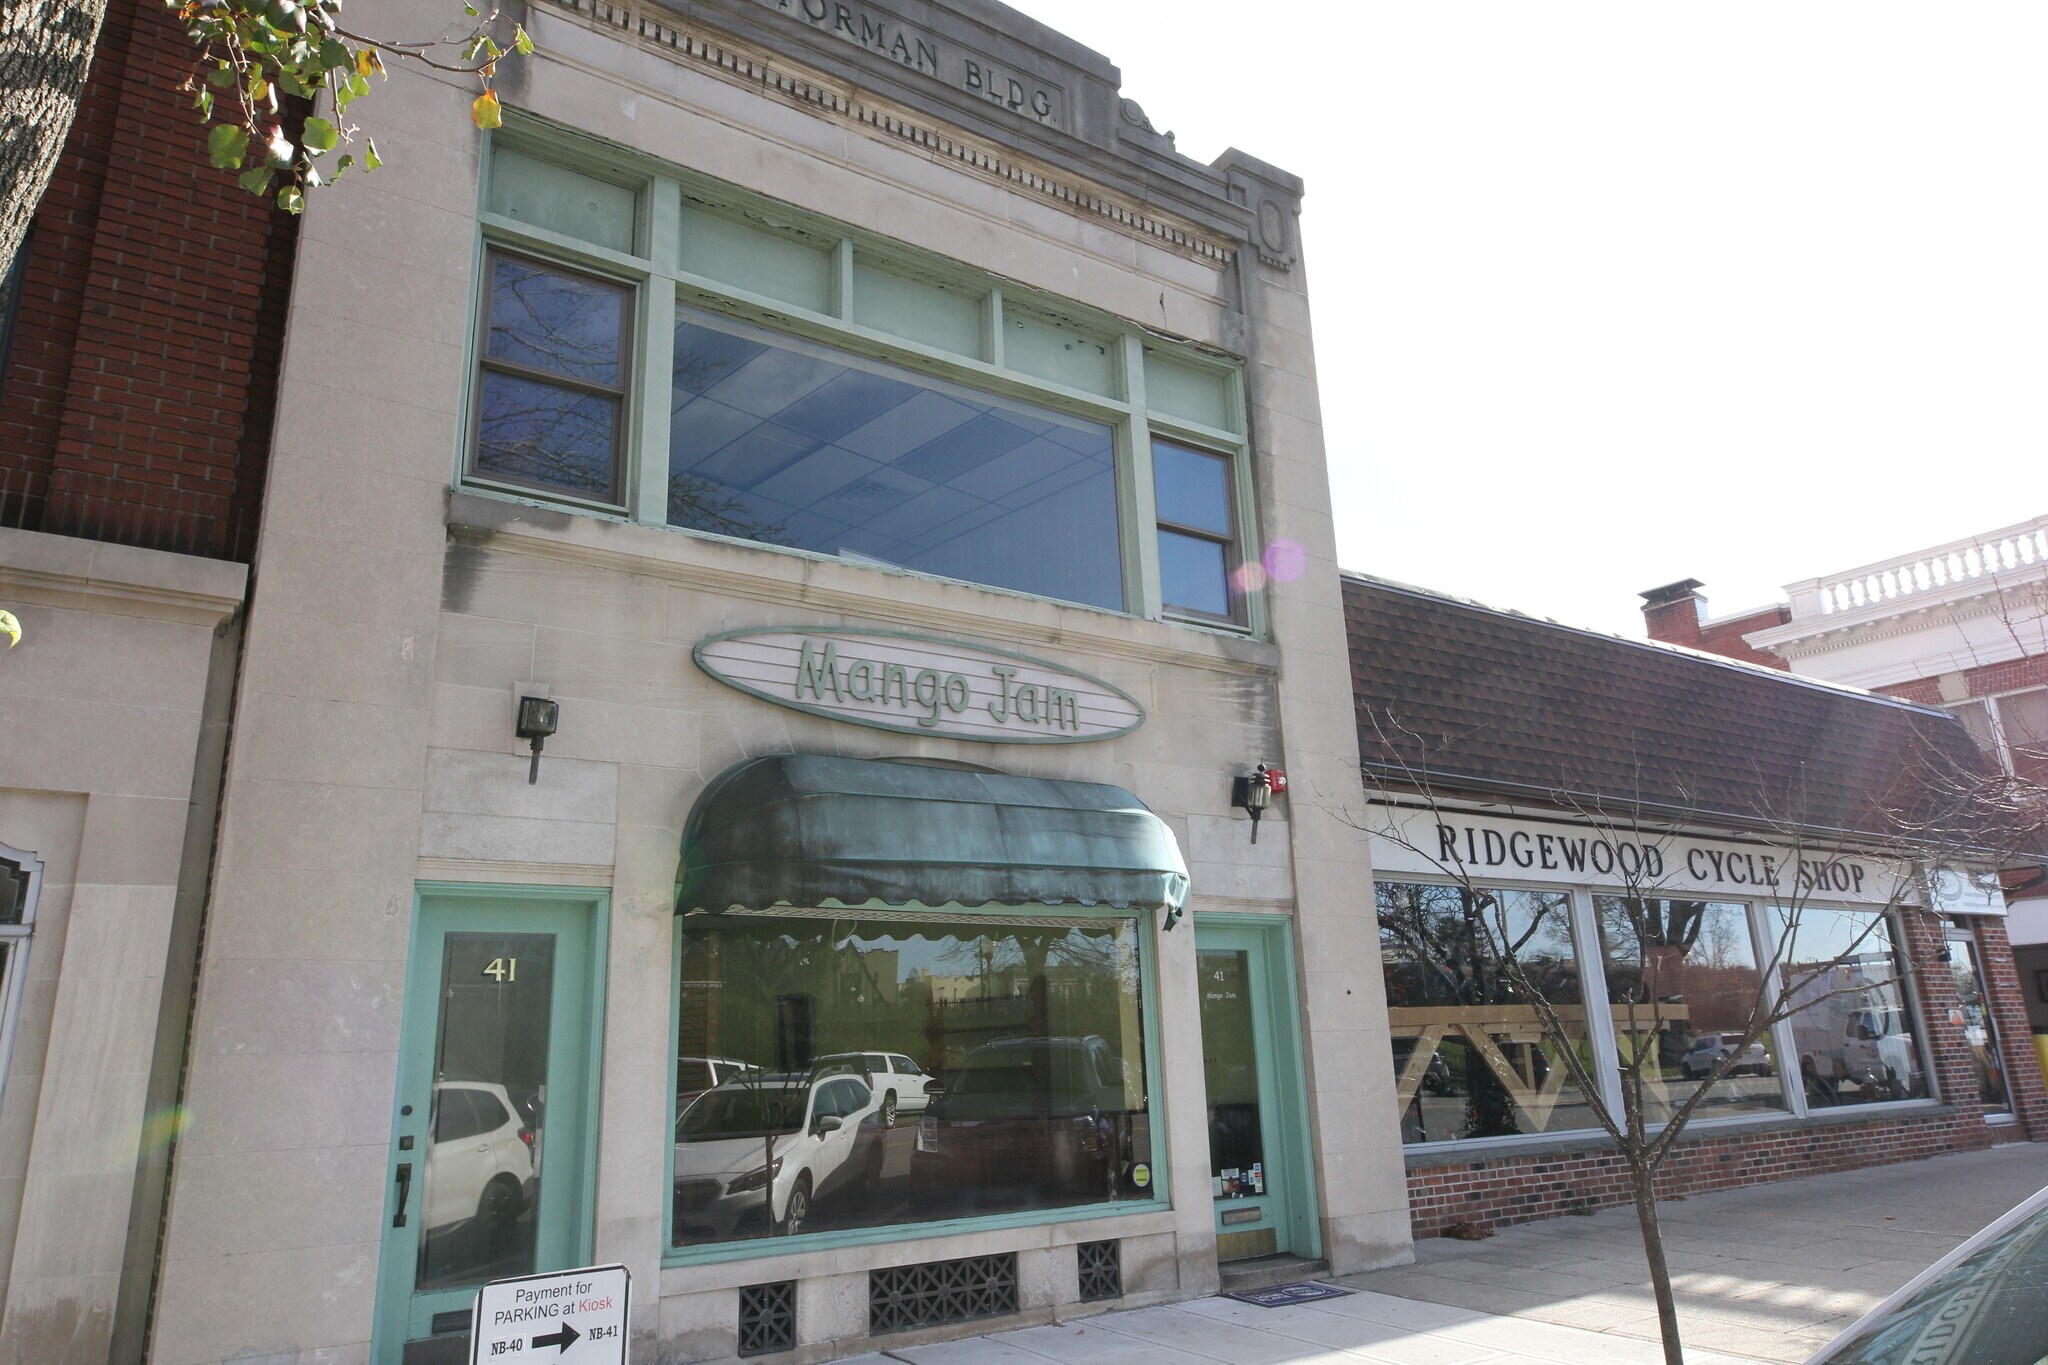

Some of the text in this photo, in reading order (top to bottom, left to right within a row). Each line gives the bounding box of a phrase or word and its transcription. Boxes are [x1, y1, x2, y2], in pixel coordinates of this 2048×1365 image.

[778, 0, 938, 71] ORMAN
[795, 639, 1081, 731] Mango Jam
[1436, 824, 1864, 892] RIDGEWOOD CYCLE SHOP
[483, 958, 516, 981] 41
[1214, 971, 1224, 981] 41
[516, 1281, 593, 1304] Payment for
[494, 1296, 613, 1325] PARKING at Kiosk
[491, 1325, 618, 1355] NB-40 NB-41
